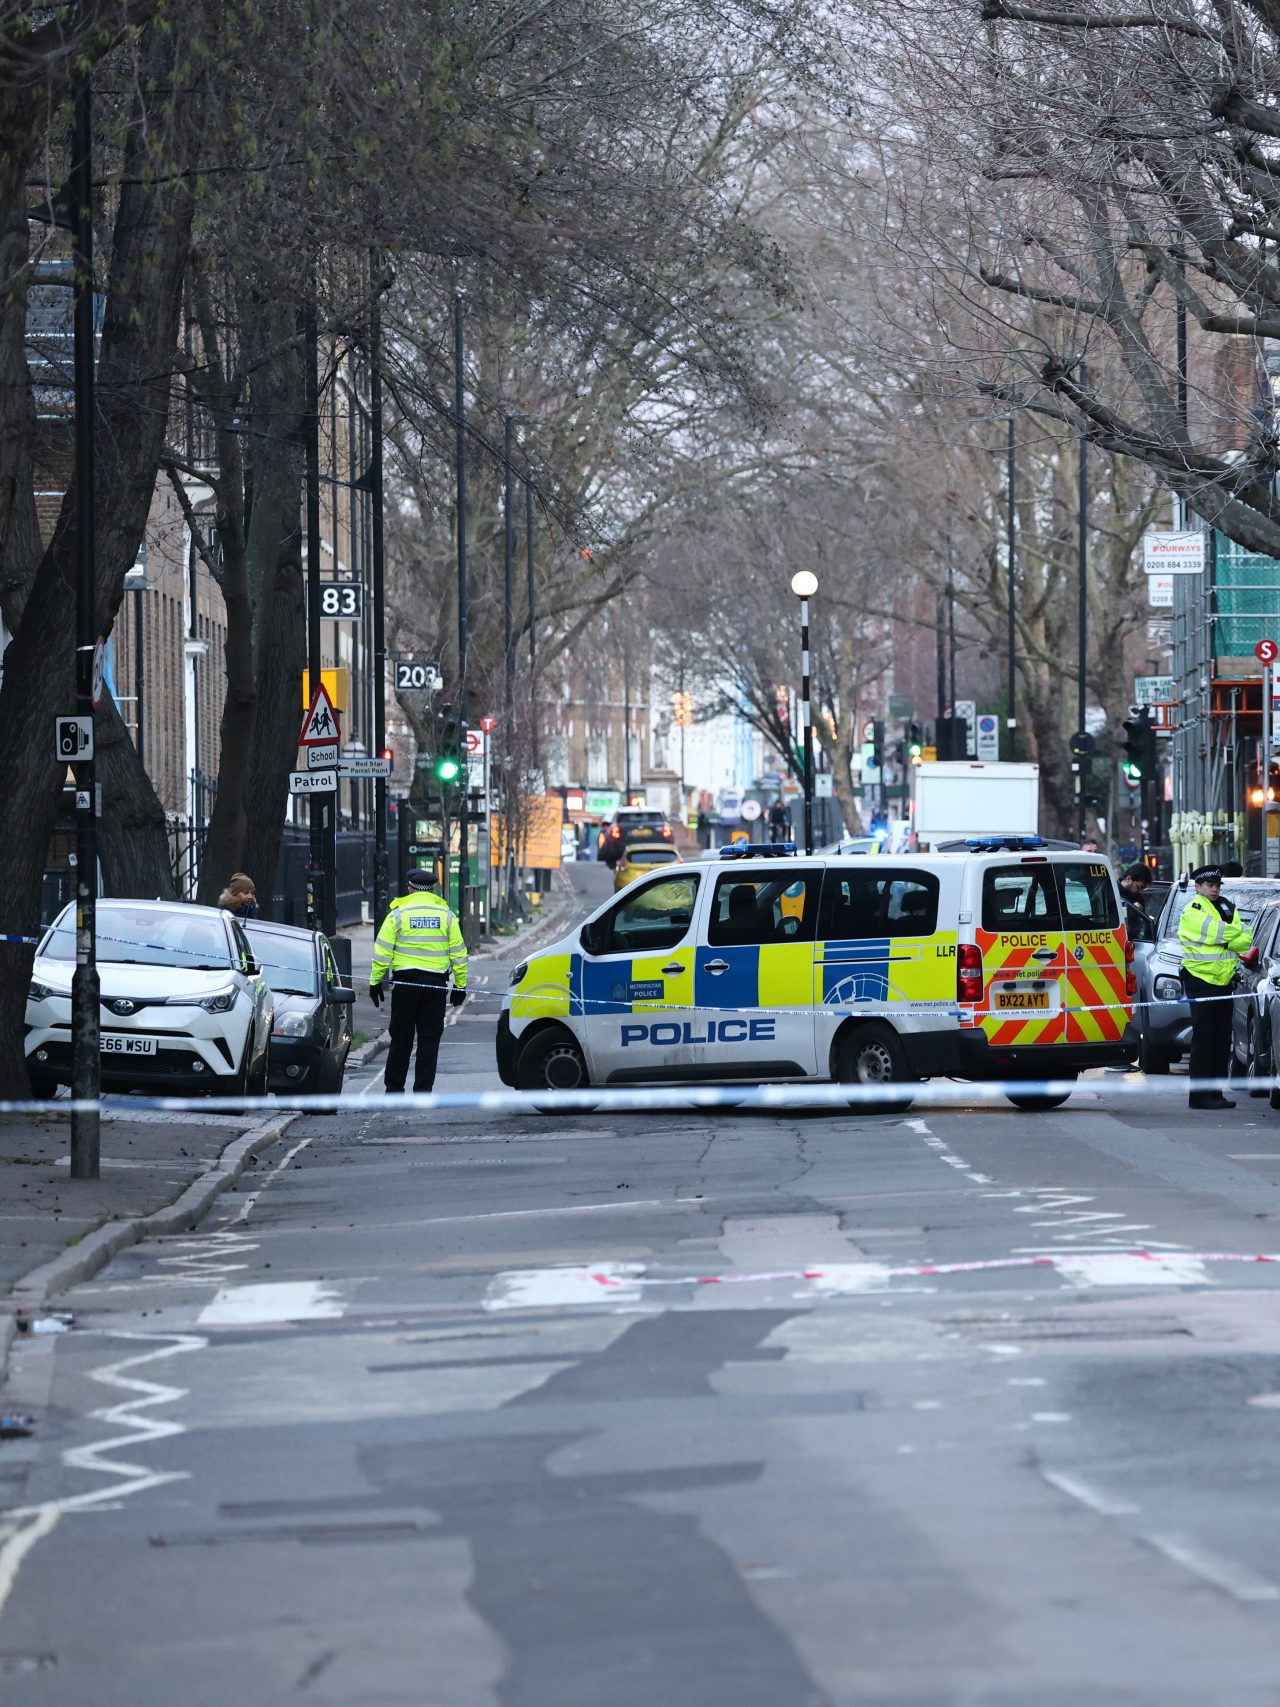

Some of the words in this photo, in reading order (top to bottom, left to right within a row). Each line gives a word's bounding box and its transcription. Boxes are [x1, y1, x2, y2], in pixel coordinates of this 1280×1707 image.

[1147, 561, 1165, 569] 0208
[1167, 561, 1181, 569] 884
[1183, 561, 1201, 569] 3339
[322, 588, 356, 614] 83
[1260, 642, 1272, 659] S
[310, 749, 335, 762] School
[294, 775, 333, 787] Patrol
[1089, 865, 1107, 877] LLR
[411, 920, 440, 928] POLICE
[1001, 934, 1047, 947] POLICE
[1075, 932, 1112, 945] POLICE
[936, 945, 956, 957] LLR
[1000, 994, 1025, 1007] BX22
[1026, 994, 1045, 1006] AYT
[620, 1018, 776, 1047] POLICE
[126, 1039, 152, 1053] WSU
